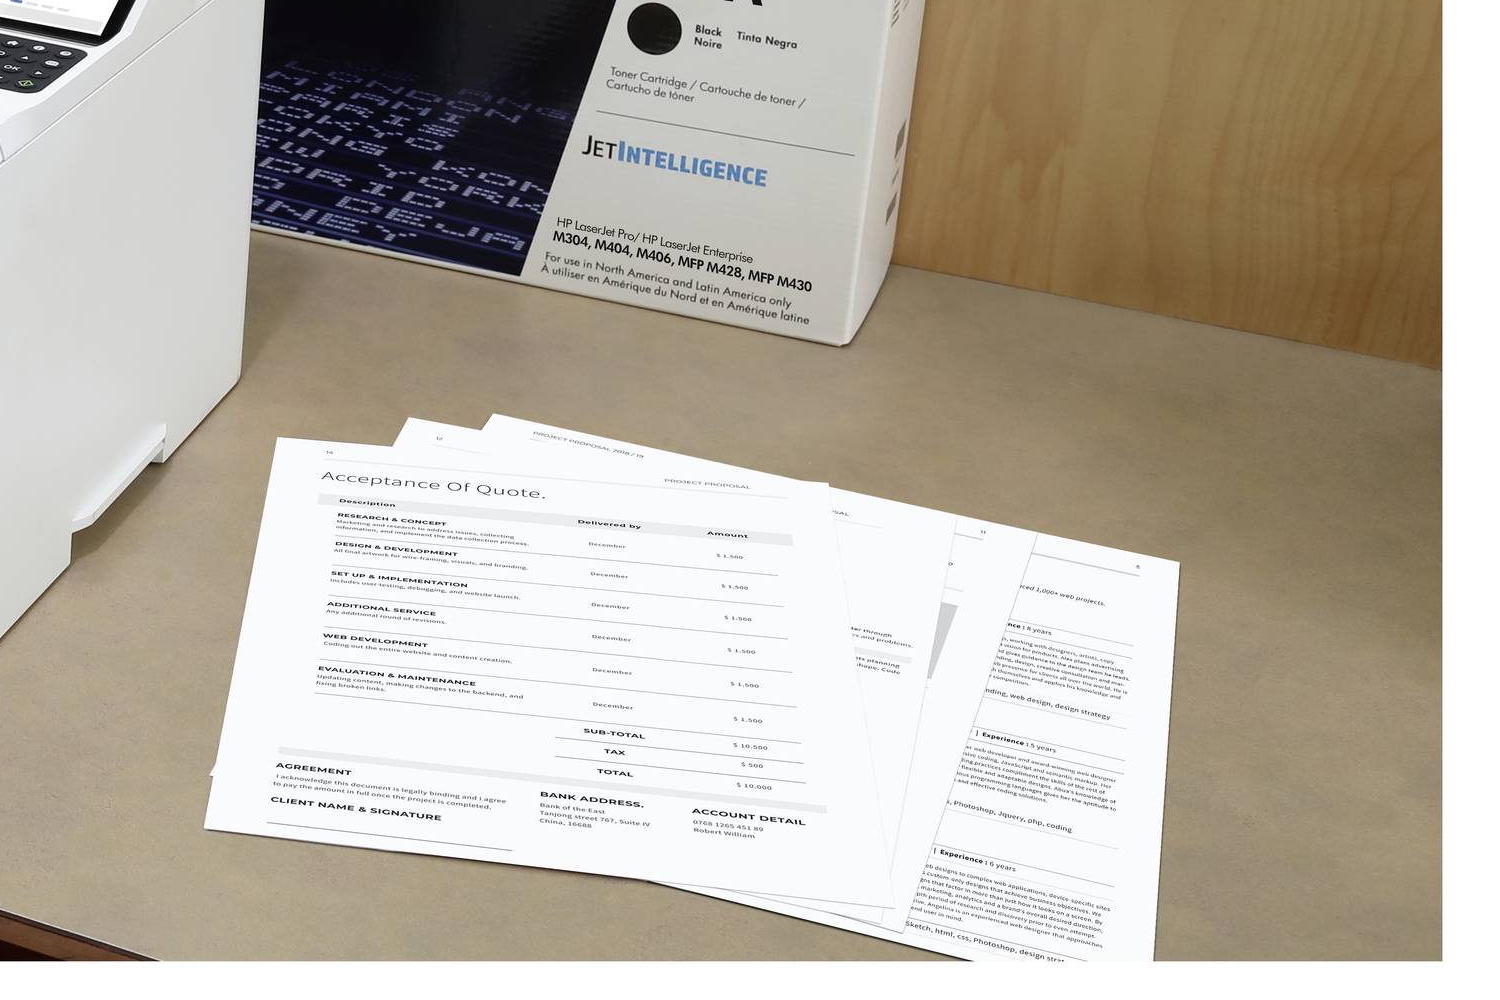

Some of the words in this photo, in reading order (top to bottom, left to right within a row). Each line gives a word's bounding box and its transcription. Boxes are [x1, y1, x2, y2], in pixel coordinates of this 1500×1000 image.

[695, 24, 722, 38] Black
[694, 37, 722, 50] Noire
[737, 31, 762, 44] Tinta
[765, 35, 797, 50] Negra
[606, 79, 651, 96] Cartucho
[654, 86, 666, 98] de
[669, 89, 694, 103] tóner
[610, 66, 637, 80] Toner
[640, 71, 687, 89] Cartridge
[699, 82, 751, 99] Cartouche
[754, 89, 767, 102] de
[770, 93, 796, 107] toner
[557, 216, 572, 229] HP
[575, 220, 615, 238] LaserJet
[642, 233, 658, 245] HP
[660, 237, 700, 254] LaserJet
[703, 246, 753, 264] Enterprise
[553, 230, 591, 249] M304,
[595, 239, 633, 258] M404,
[637, 247, 674, 267] M406,
[678, 256, 704, 271] MFP
[706, 262, 745, 281] M428,
[748, 269, 774, 285] MFP
[777, 276, 812, 292] M430
[545, 252, 561, 263] For
[564, 258, 580, 268] use
[583, 258, 593, 269] in
[596, 261, 624, 277] North
[627, 268, 670, 286] America
[673, 278, 693, 290] and
[696, 281, 720, 294] Latin
[722, 287, 766, 304] America
[769, 297, 792, 310] only
[551, 265, 584, 281] utiliser
[588, 275, 600, 284] en
[603, 275, 651, 295] Amérique
[654, 285, 667, 297] du
[670, 289, 698, 304] Nord
[699, 296, 709, 305] et
[711, 300, 724, 309] en
[727, 300, 777, 320] Amérique
[780, 310, 810, 326] latine
[321, 471, 440, 490] Acceptance
[447, 481, 470, 492] Of
[477, 484, 546, 500] Quote.
[339, 498, 396, 509] Description
[338, 512, 389, 522] RESEARCH
[401, 518, 447, 527] CONCEPT
[578, 519, 626, 528] Delivered
[707, 531, 749, 539] Amount
[335, 541, 372, 549] DESIGN
[384, 545, 458, 557] DEVELOPMENT
[378, 575, 468, 588] IMPLEMENTATION
[1060, 591, 1074, 600] web
[1076, 595, 1106, 607] projects.
[327, 601, 390, 612] ADDITIONAL
[393, 608, 436, 616] SERVICE
[350, 635, 428, 648] DEVELOPMENT
[318, 666, 385, 678] EVALUATION
[398, 674, 476, 687] MAINTENANCE
[1010, 693, 1025, 701] web
[1027, 695, 1053, 708] design,
[1055, 702, 1079, 713] design
[1081, 708, 1110, 720] strategy
[584, 728, 646, 740] SUB-TOTAL
[982, 731, 1024, 746] Experience
[1036, 745, 1056, 753] years
[276, 762, 352, 776] AGREEMENT
[597, 768, 633, 778] TOTAL
[540, 791, 577, 801] BANK
[580, 795, 644, 809] ADDRESS.
[540, 802, 561, 810] Bank
[271, 796, 314, 807] CLIENT
[318, 801, 355, 812] NAME
[370, 807, 442, 822] SIGNATURE
[540, 810, 572, 820] Tanjong
[692, 808, 756, 821] ACCOUNT
[760, 815, 806, 826] DETAIL
[954, 800, 996, 815] Photoshop,
[1028, 817, 1045, 826] php,
[1047, 823, 1073, 833] coding
[539, 818, 565, 826] China,
[693, 827, 722, 836] Robert
[724, 830, 756, 839] William
[940, 849, 983, 864] Experience
[996, 863, 1016, 872] years
[935, 927, 955, 938] html,
[957, 934, 971, 943] css,
[973, 937, 1018, 954] Photoshop,
[1019, 949, 1045, 960] design
